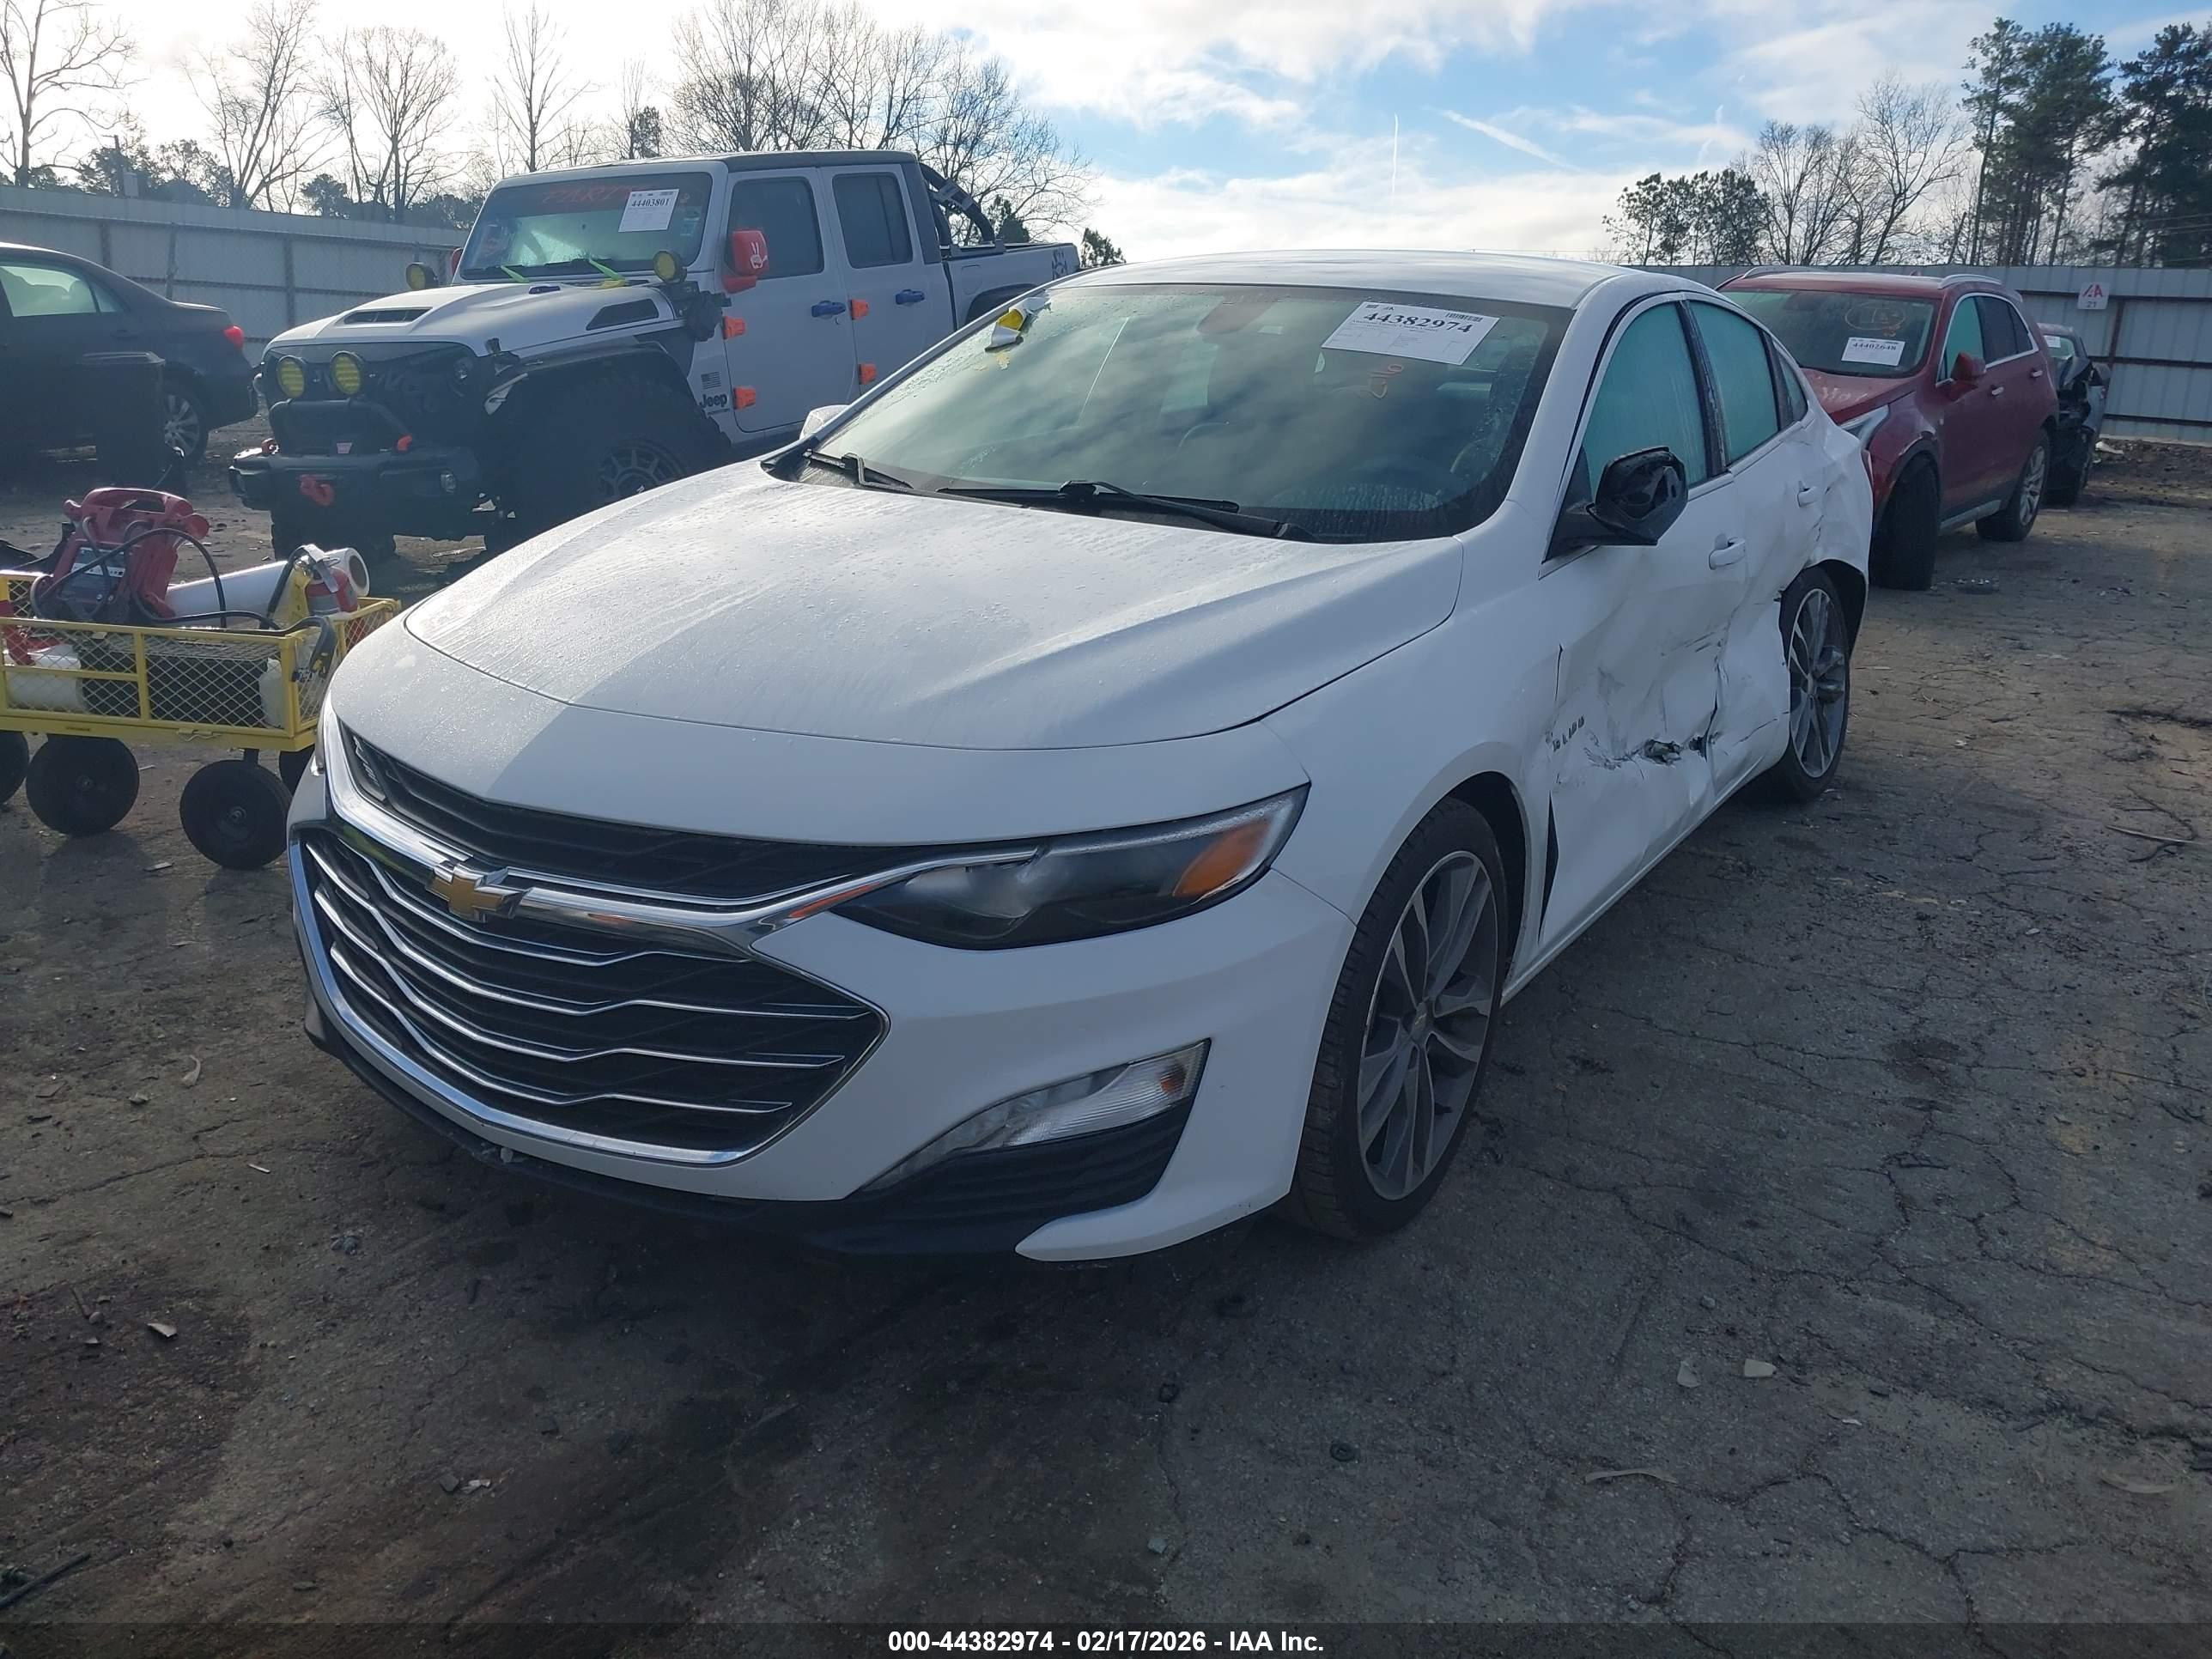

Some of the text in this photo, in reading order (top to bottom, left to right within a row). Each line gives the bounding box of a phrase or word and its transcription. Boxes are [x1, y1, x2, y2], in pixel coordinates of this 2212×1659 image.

[631, 198, 670, 208] 44403801
[1364, 312, 1474, 333] 44382974
[699, 393, 727, 409] Jeep
